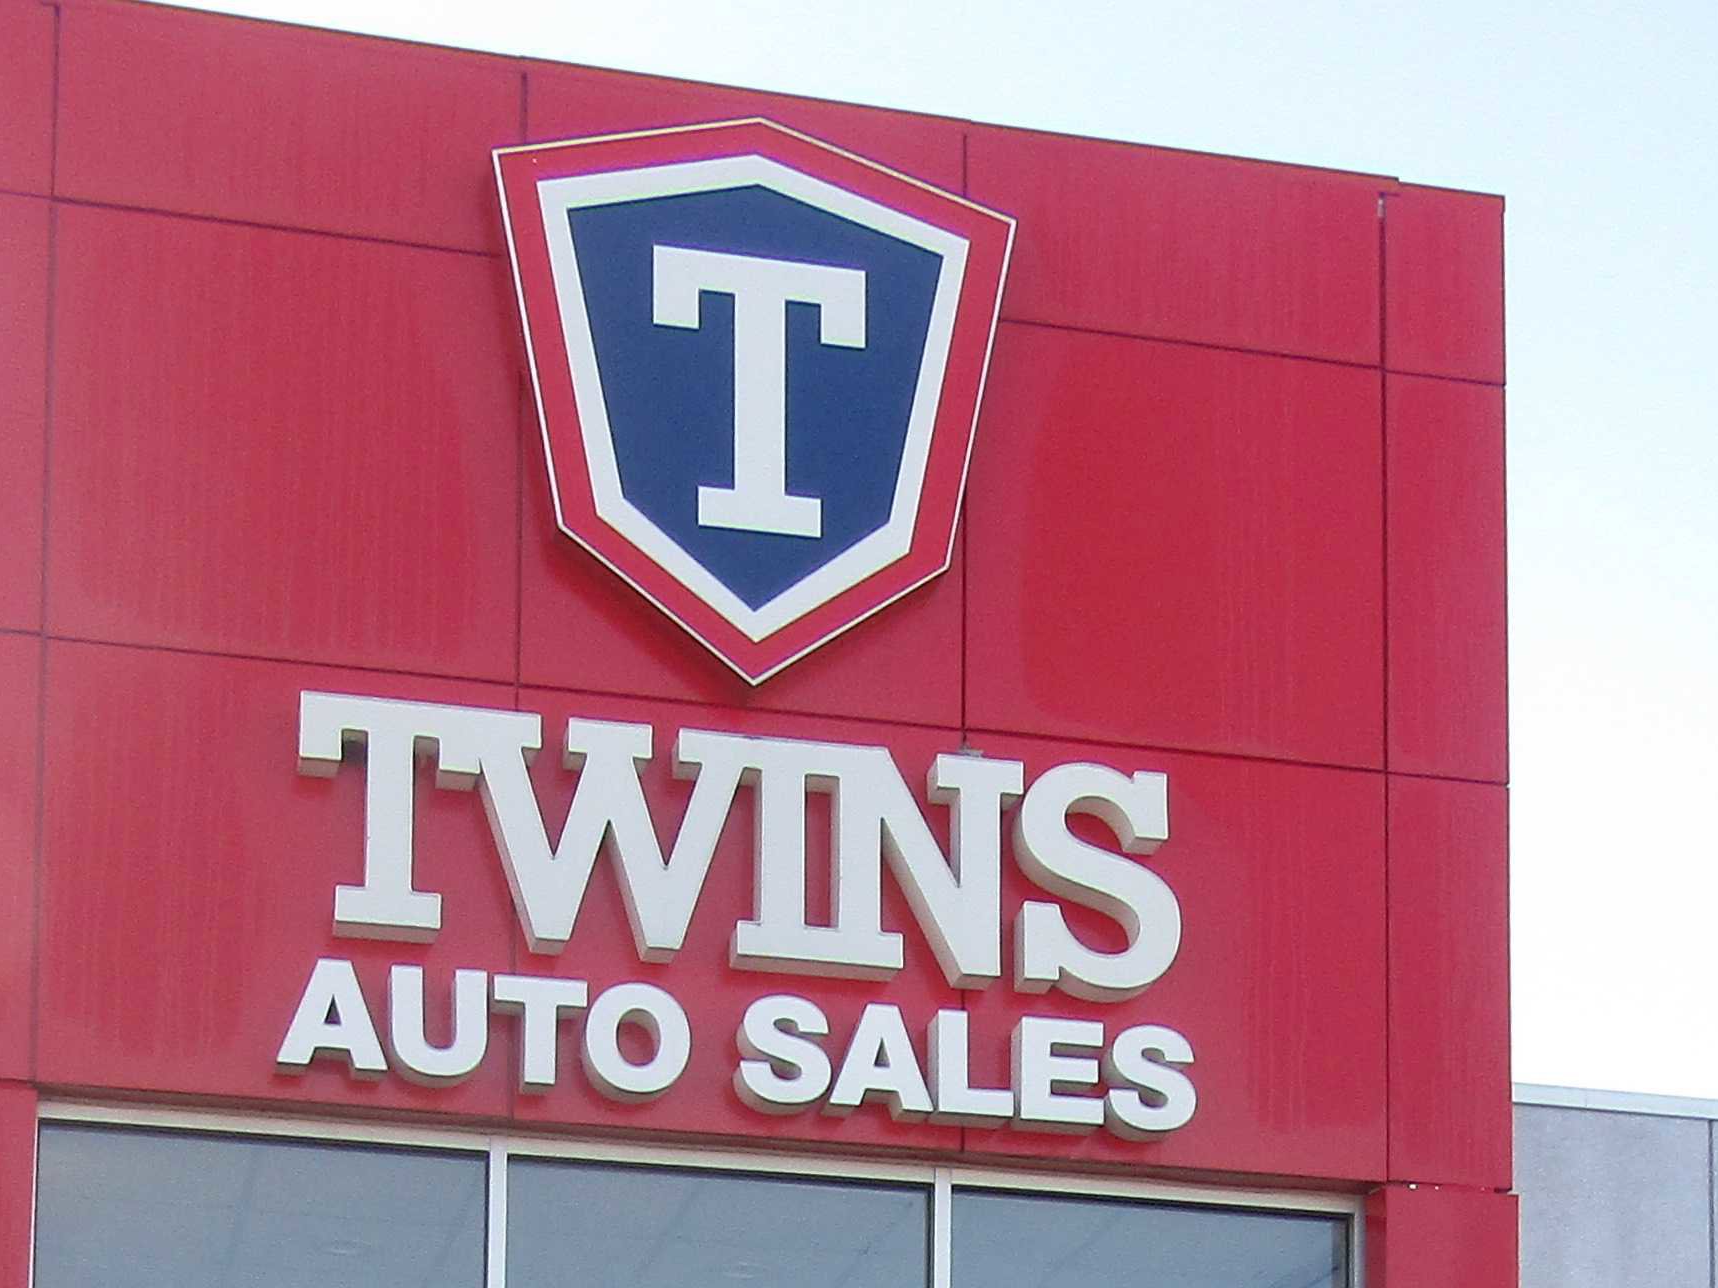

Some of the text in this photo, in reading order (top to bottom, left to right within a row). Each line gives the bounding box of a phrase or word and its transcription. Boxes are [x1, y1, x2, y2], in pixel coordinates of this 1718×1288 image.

[653, 245, 866, 538] T
[298, 690, 1181, 999] TWINS
[277, 957, 1197, 1142] AUTO SALES
